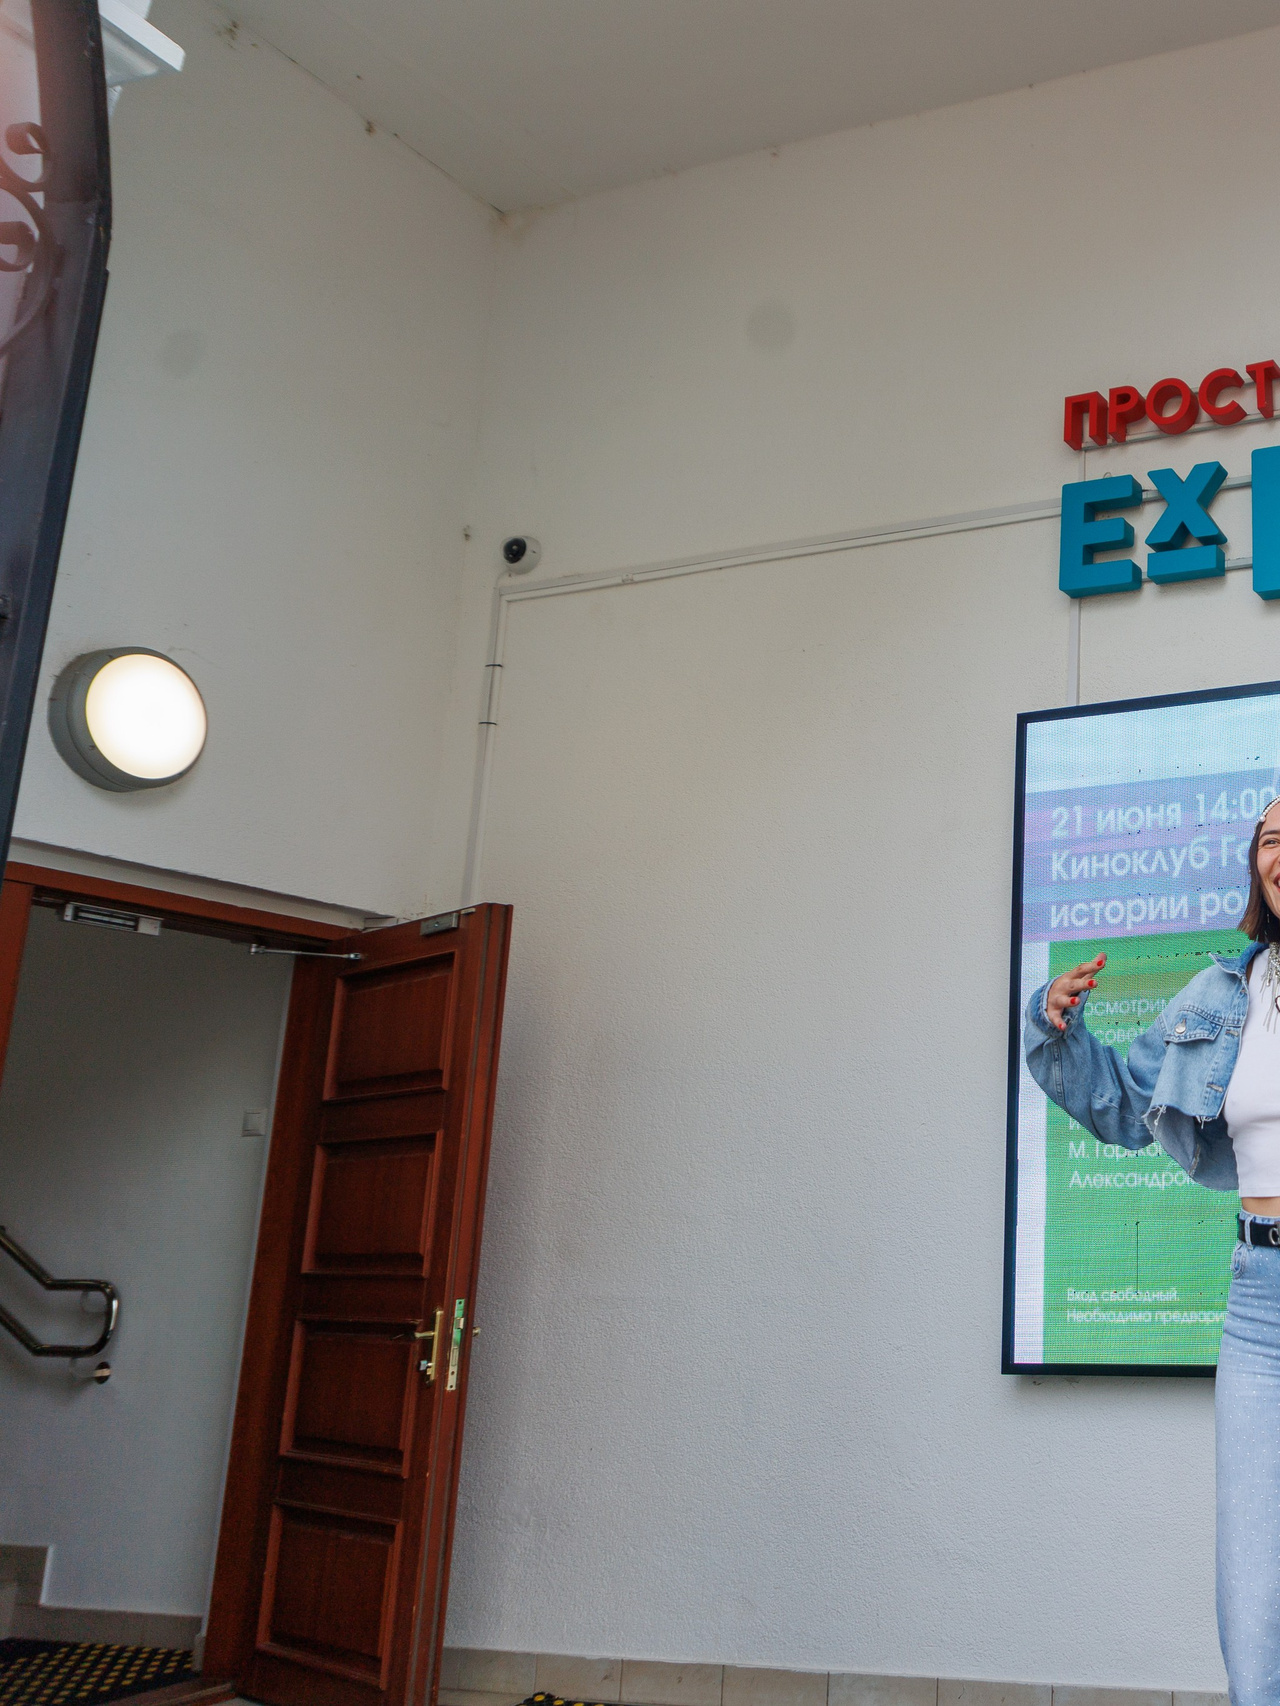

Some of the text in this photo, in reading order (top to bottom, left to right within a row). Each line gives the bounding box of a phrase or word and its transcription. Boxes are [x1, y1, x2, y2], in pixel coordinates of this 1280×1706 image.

[1051, 805, 1083, 837] 21
[1097, 802, 1181, 832] июня
[1051, 836, 1210, 881] Киноклуб
[1050, 891, 1189, 929] истории
[1084, 998, 1168, 1017] осмотри
[1067, 1288, 1098, 1304] Вход
